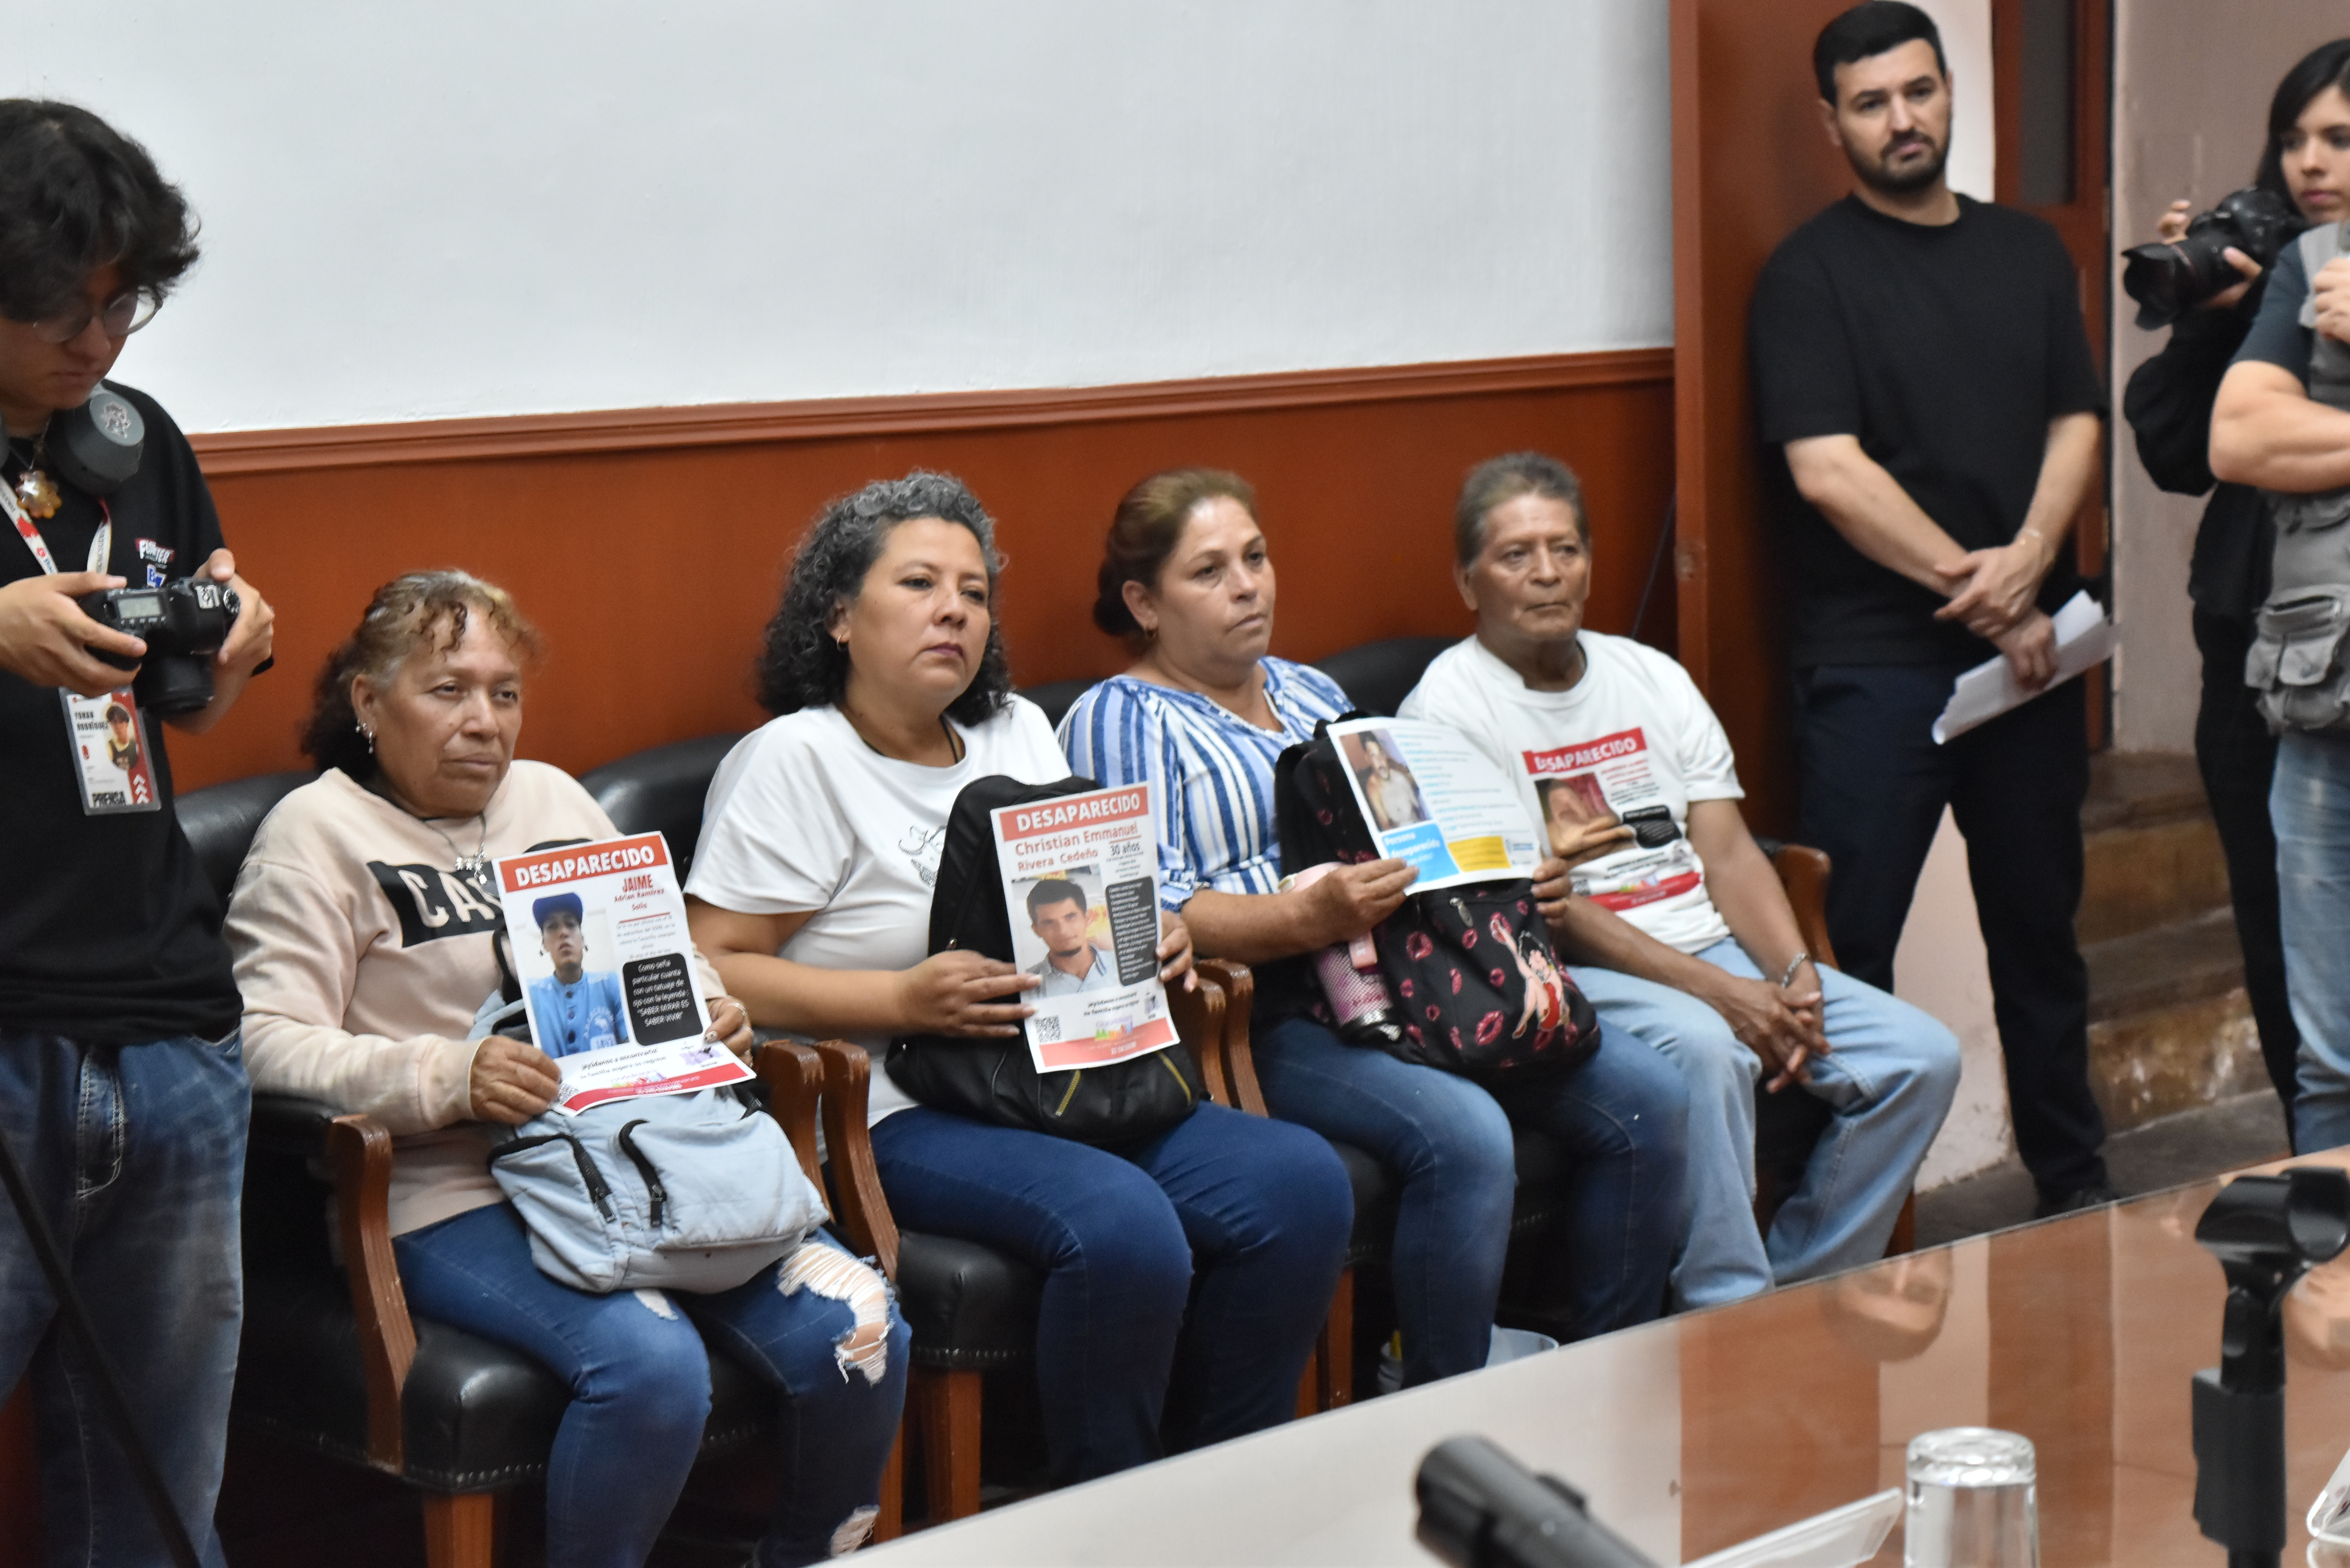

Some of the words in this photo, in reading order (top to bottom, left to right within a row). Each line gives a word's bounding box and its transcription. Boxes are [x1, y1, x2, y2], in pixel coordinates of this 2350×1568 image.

[1016, 792, 1140, 832] DESAPARECIDO
[1015, 835, 1080, 856] Christian
[1084, 822, 1138, 843] Emmanuel
[1110, 844, 1120, 856] 30
[1122, 841, 1140, 854] años
[515, 846, 655, 887] DESAPARECIDO
[1018, 857, 1054, 872] Rivera
[1060, 848, 1098, 863] Cedeño
[623, 874, 653, 892] JAIME
[638, 964, 655, 973] Como
[632, 973, 660, 986] particular
[654, 981, 675, 992] tatuaje
[675, 978, 684, 987] de
[632, 998, 643, 1008] ojo
[643, 997, 655, 1005] con
[655, 994, 662, 1002] la
[660, 1000, 681, 1012] MIRAR
[681, 999, 690, 1009] ES
[644, 1015, 664, 1027] SABER
